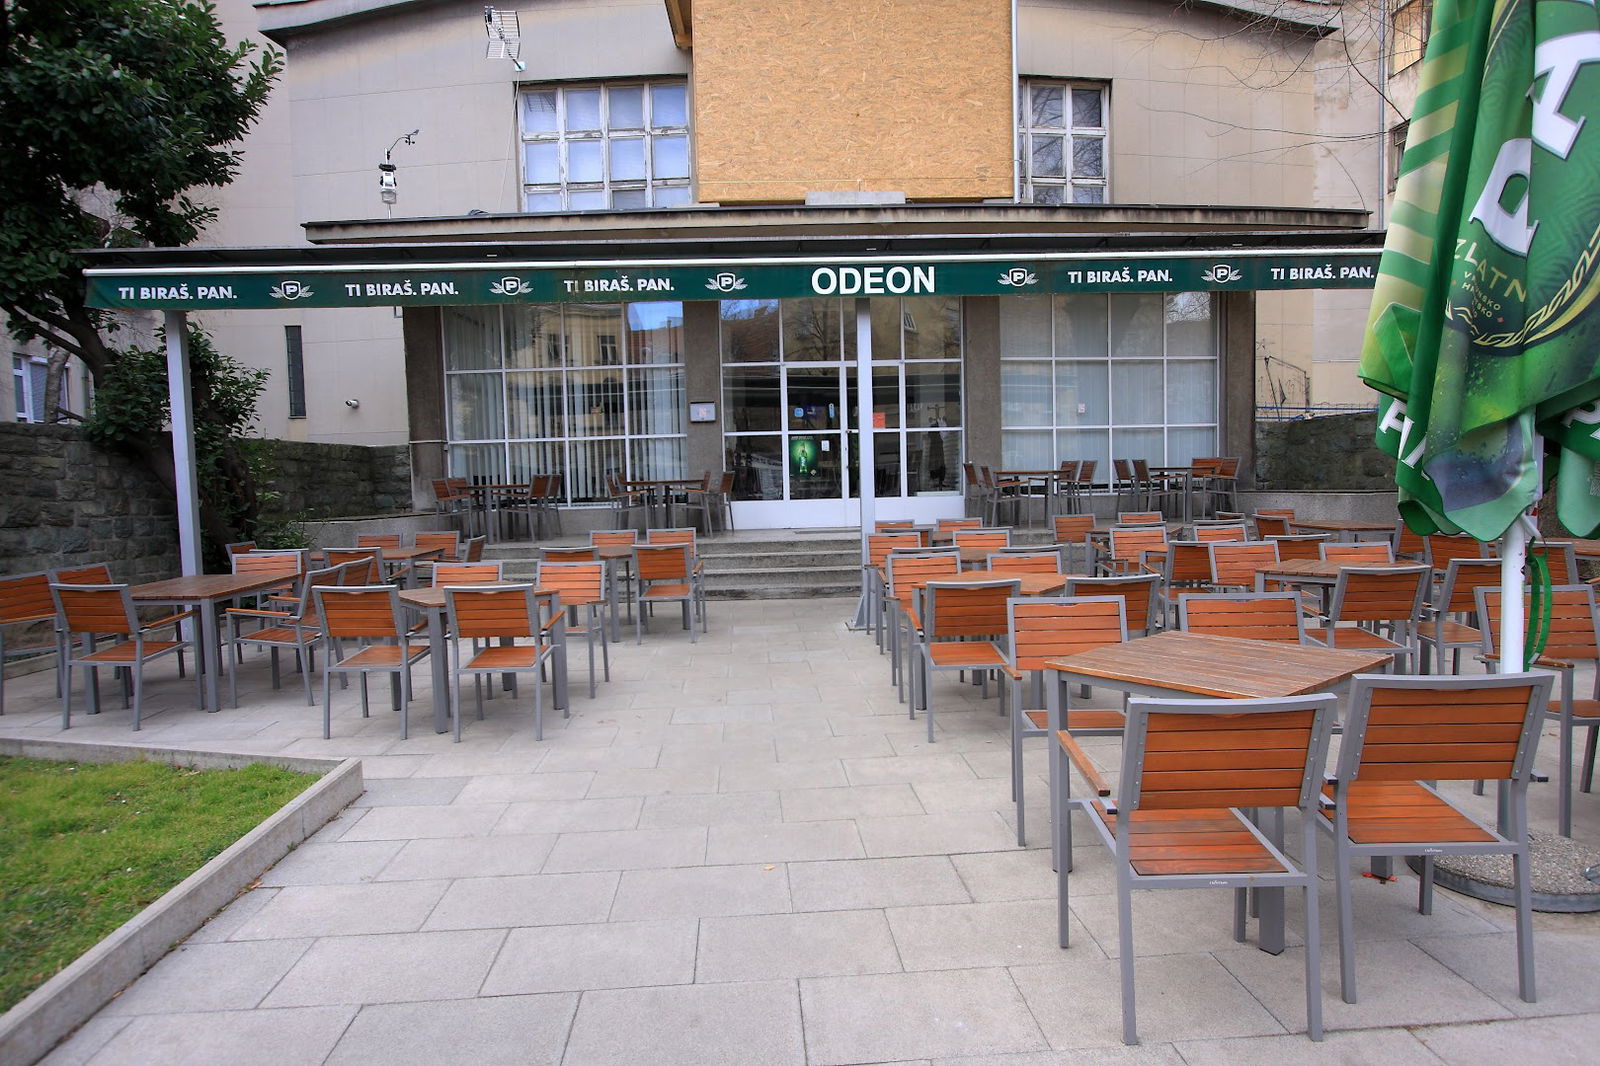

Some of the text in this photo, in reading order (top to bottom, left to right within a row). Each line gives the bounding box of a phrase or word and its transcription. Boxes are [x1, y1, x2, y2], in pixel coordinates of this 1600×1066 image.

[811, 266, 936, 295] ODEON
[1067, 266, 1173, 284] TI BIRAŠ. PAN.
[1270, 263, 1375, 280] TI BIRAŠ. PAN.
[118, 283, 238, 300] TI BIRAŠ. PAN.
[345, 279, 459, 297] TI BIRAŠ. PAN.
[564, 275, 675, 293] TI BIRAŠ. PAN.
